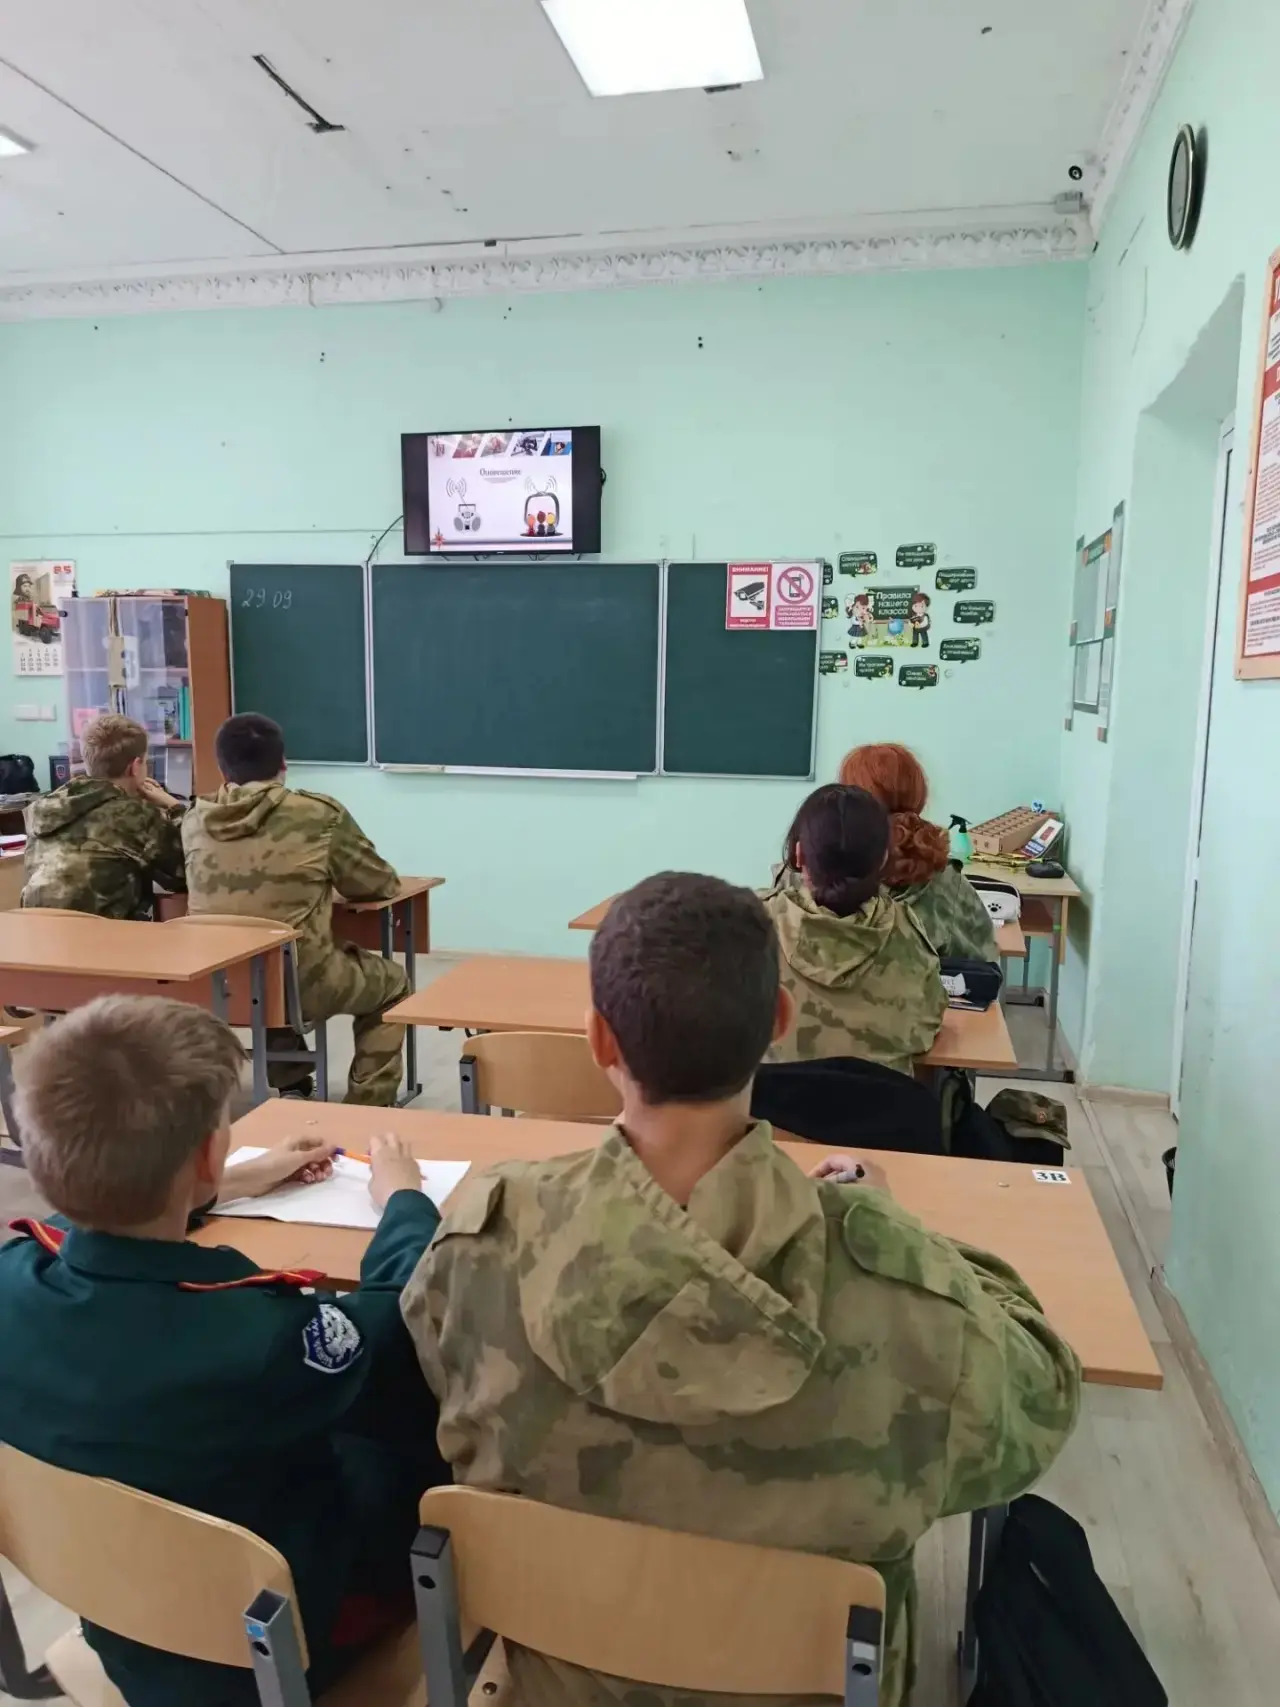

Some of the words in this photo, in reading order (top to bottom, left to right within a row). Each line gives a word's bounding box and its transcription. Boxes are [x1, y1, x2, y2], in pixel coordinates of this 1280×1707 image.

[241, 588, 266, 609] 29
[272, 590, 292, 610] 09
[876, 591, 912, 601] Правила
[878, 600, 909, 608] нашего
[878, 608, 909, 616] класса
